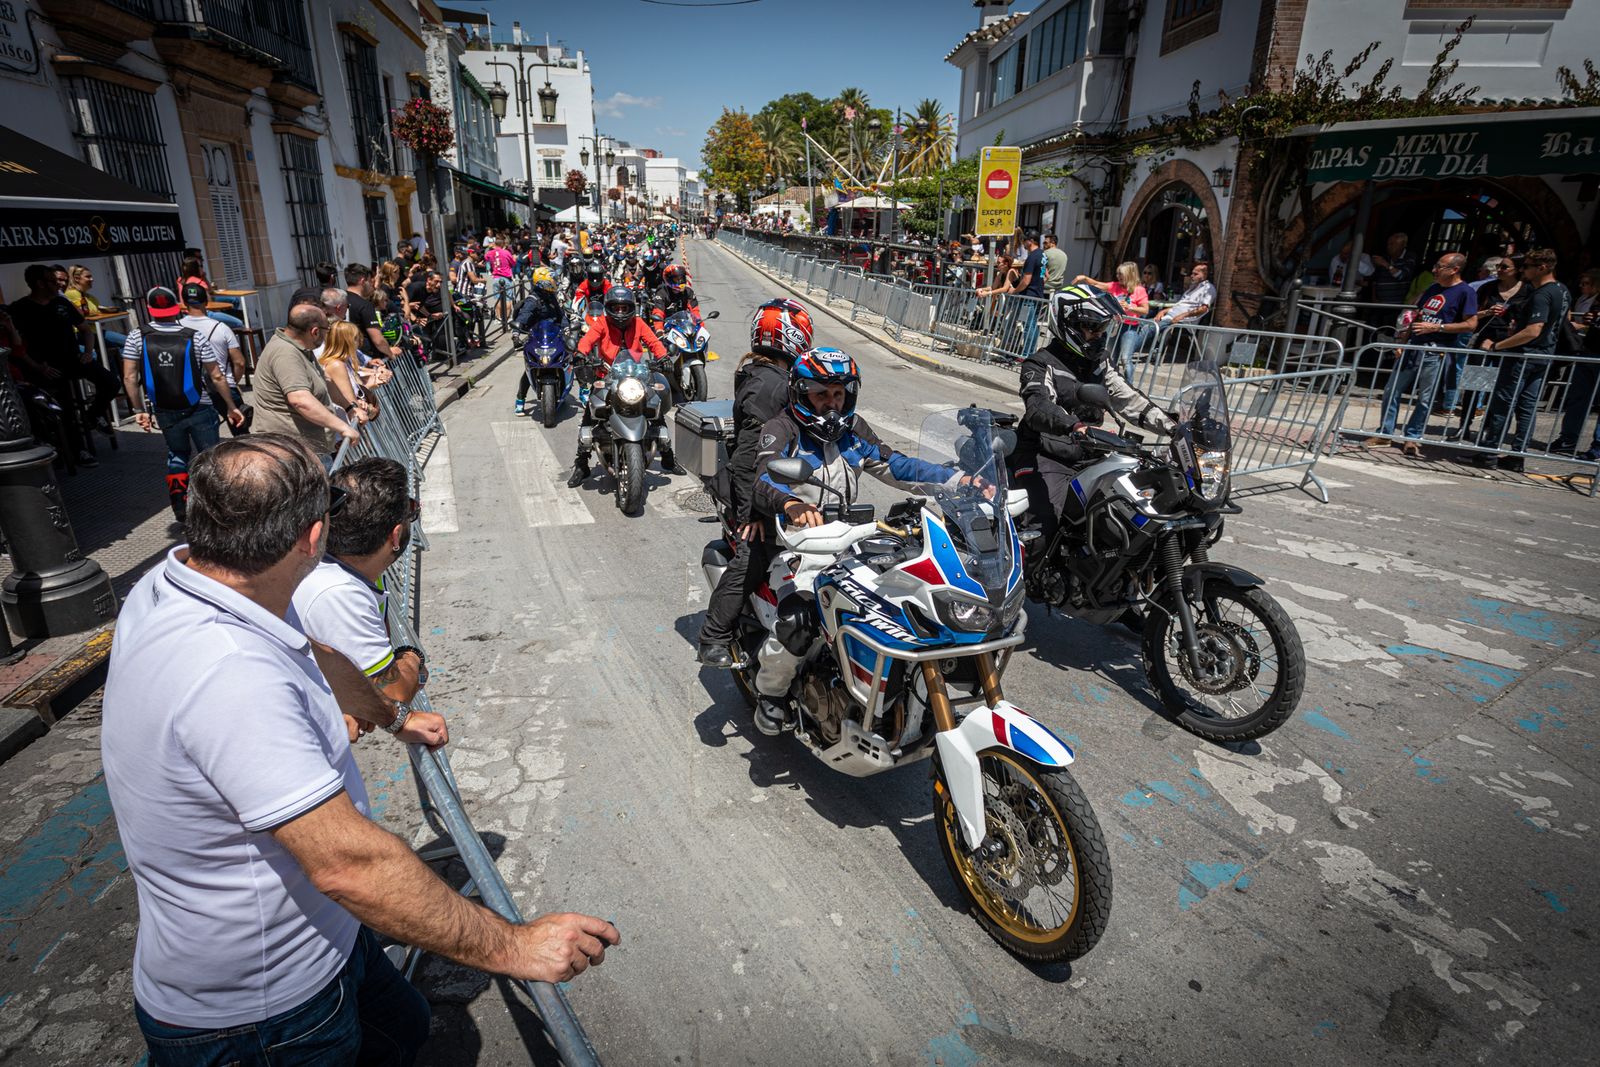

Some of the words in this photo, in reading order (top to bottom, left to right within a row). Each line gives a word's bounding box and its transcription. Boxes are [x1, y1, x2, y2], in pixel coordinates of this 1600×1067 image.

[0, 43, 32, 62] ISCO
[1389, 132, 1479, 156] MENU
[1540, 131, 1600, 158] Ba
[1311, 145, 1374, 169] TAPAS
[1372, 156, 1426, 177] DEL
[1436, 153, 1488, 175] DIA
[0, 226, 60, 247] AERAS
[60, 226, 93, 245] 1928
[109, 226, 131, 243] SIN
[132, 225, 176, 242] GLUTEN
[828, 563, 885, 613] Africa
[849, 607, 929, 646] Twin
